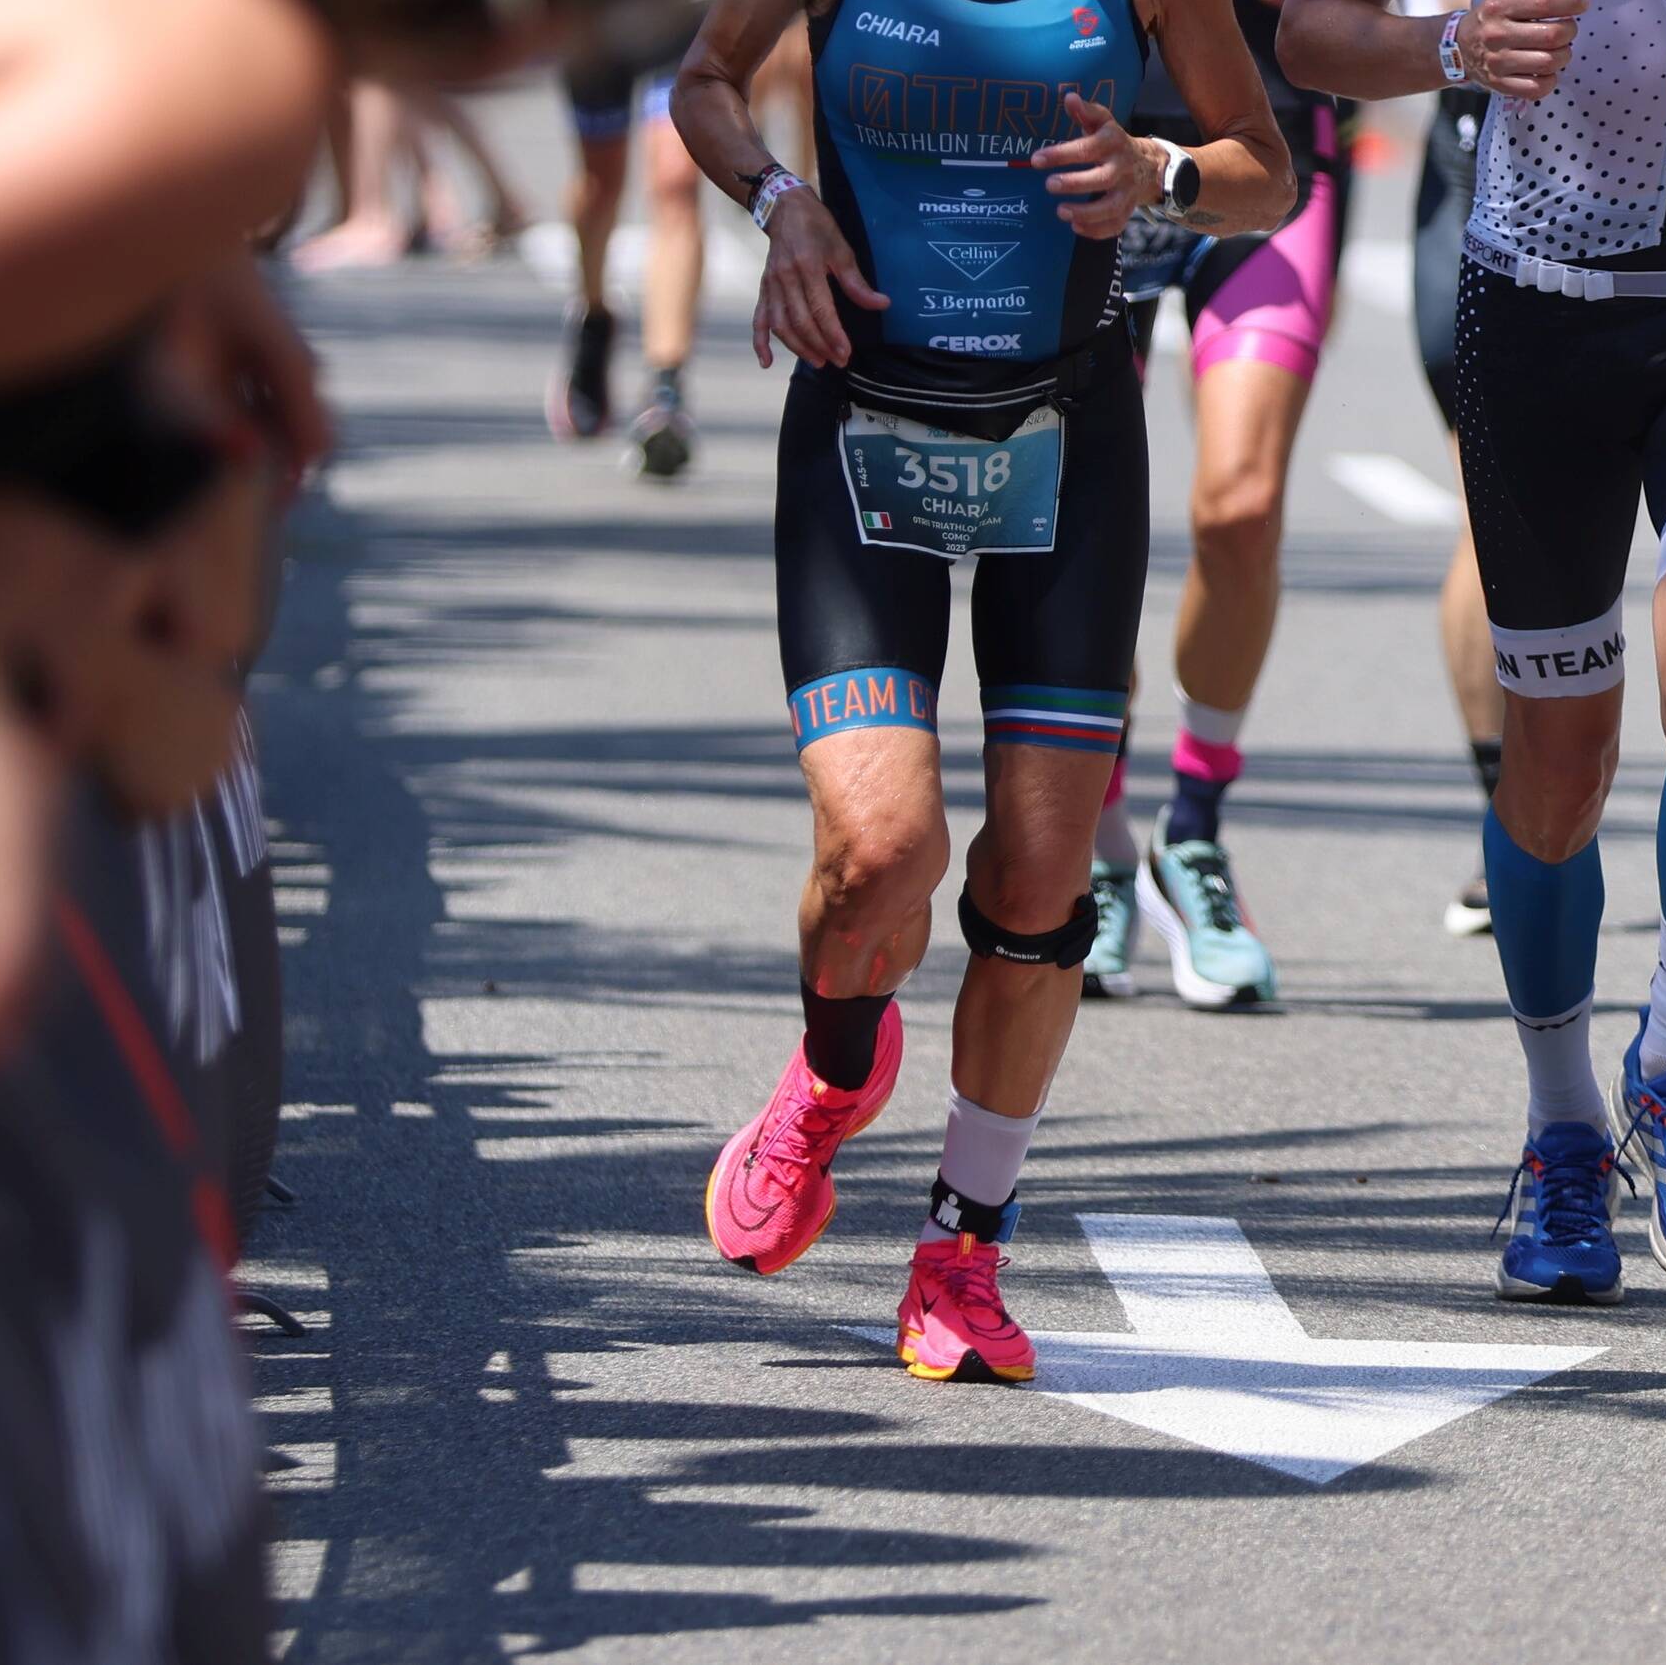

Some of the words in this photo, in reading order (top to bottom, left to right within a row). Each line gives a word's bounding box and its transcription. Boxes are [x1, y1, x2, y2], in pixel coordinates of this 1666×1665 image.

[855, 11, 940, 47] CHIARA
[854, 124, 969, 153] TRIATHLON
[979, 134, 1031, 154] TEAM
[918, 199, 1029, 216] masterpack
[948, 246, 998, 259] Cellini
[923, 292, 1026, 310] S.Bernardo
[928, 333, 1022, 352] CEROX
[854, 449, 869, 487] F45-49
[895, 447, 1011, 496] 3518
[922, 497, 989, 518] CHIARA
[942, 532, 970, 542] COMO
[945, 543, 966, 552] 2023
[1527, 632, 1623, 678] TEAM
[803, 677, 895, 729] TEAM
